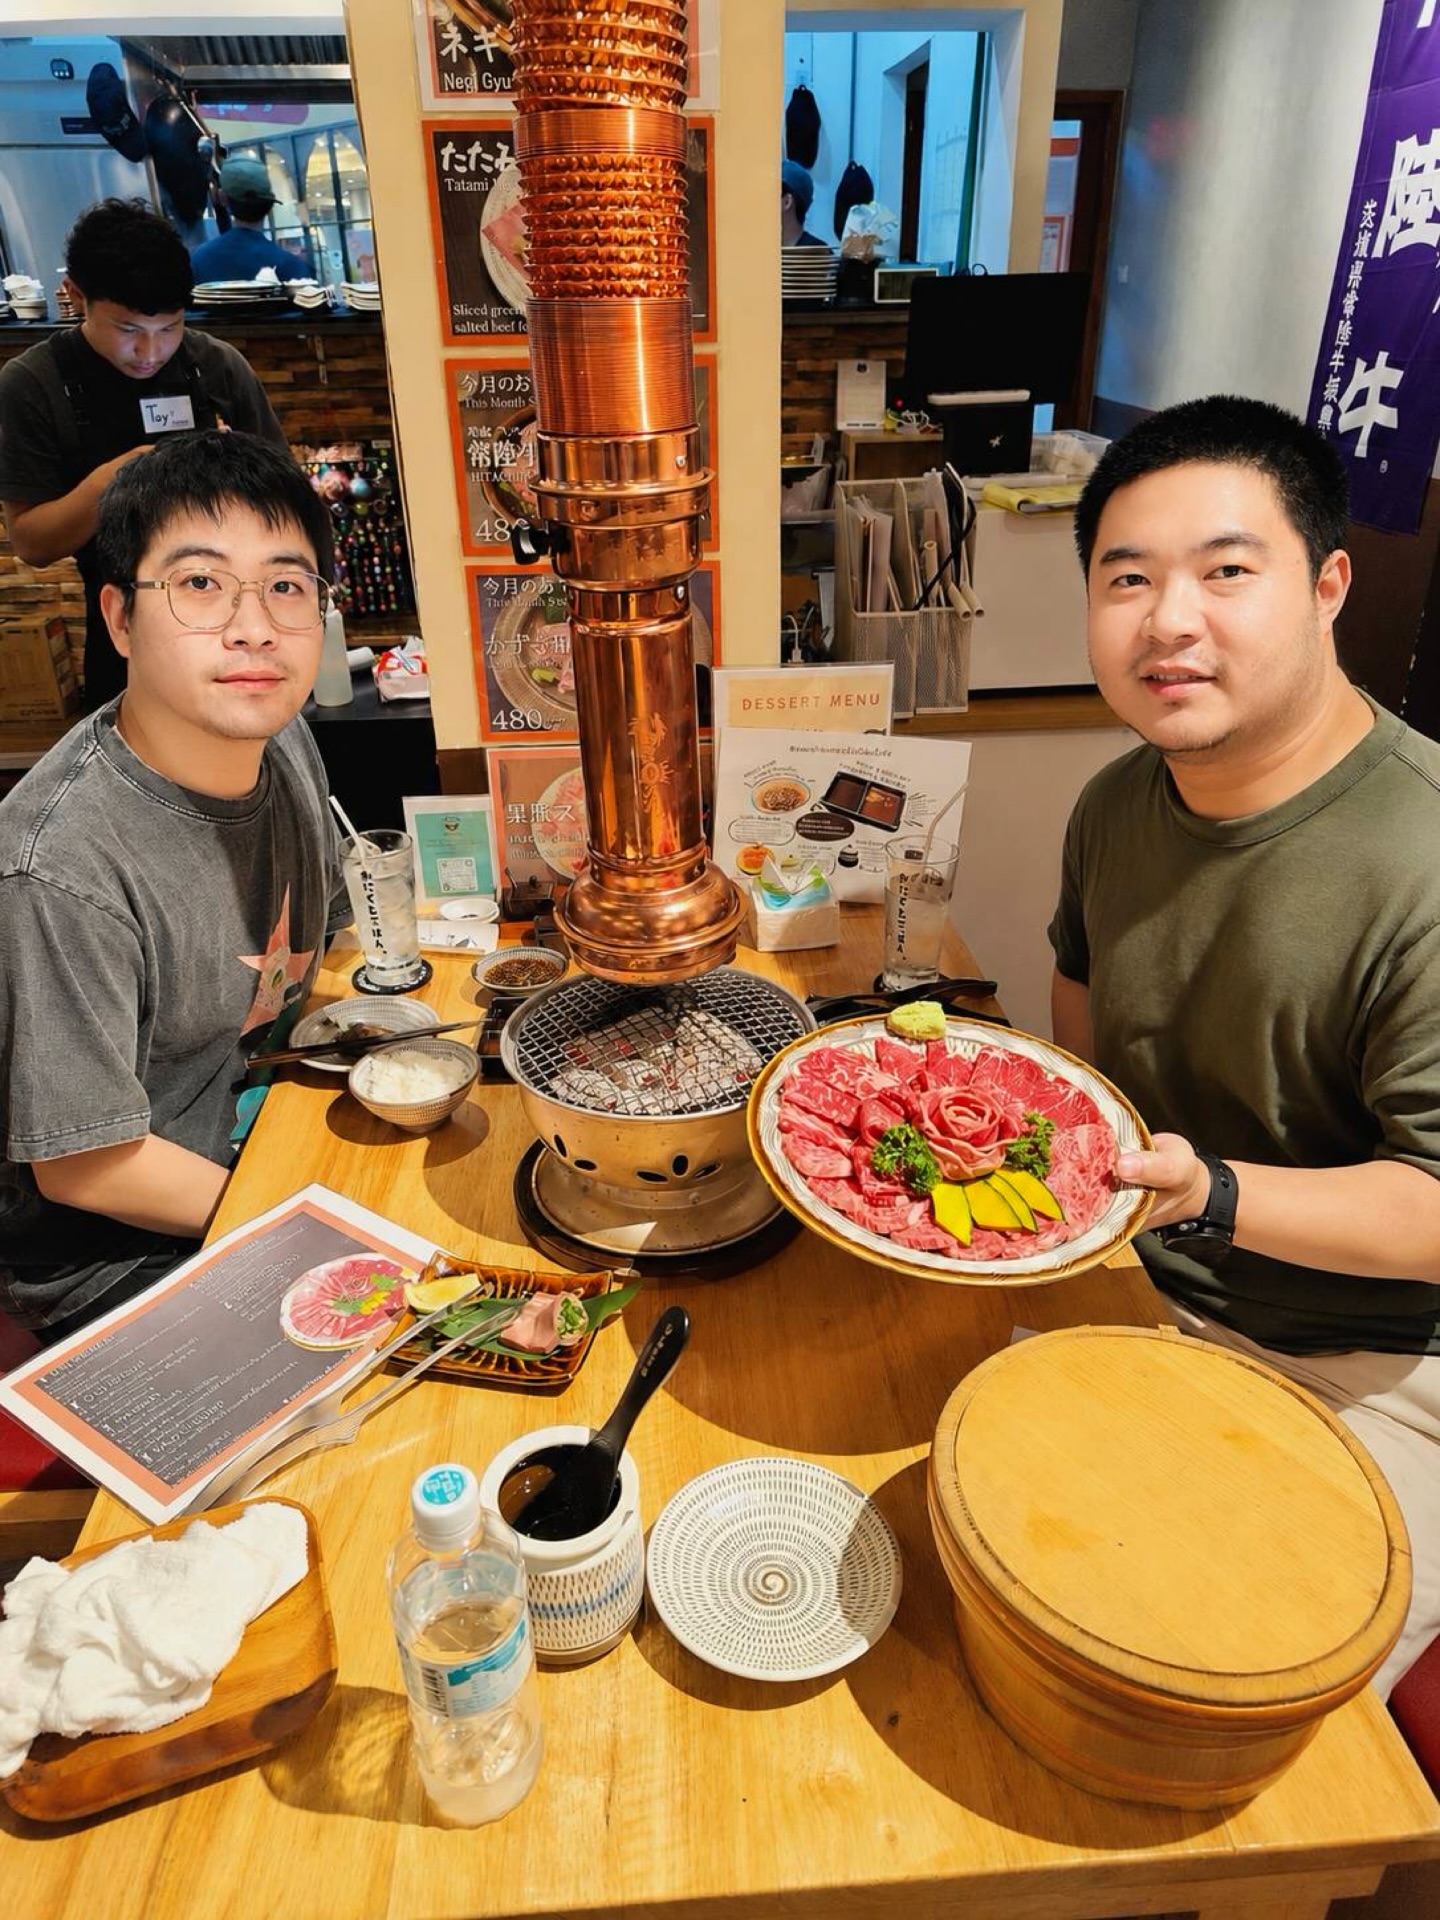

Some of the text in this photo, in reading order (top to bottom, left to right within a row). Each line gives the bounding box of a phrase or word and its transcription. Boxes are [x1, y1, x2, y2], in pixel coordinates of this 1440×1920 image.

[443, 72, 478, 94] Negi
[444, 178, 489, 192] Tatami
[452, 304, 488, 316] Sliced
[454, 320, 489, 334] salted
[742, 693, 881, 711] DESSERT MENU
[492, 708, 542, 731] 480
